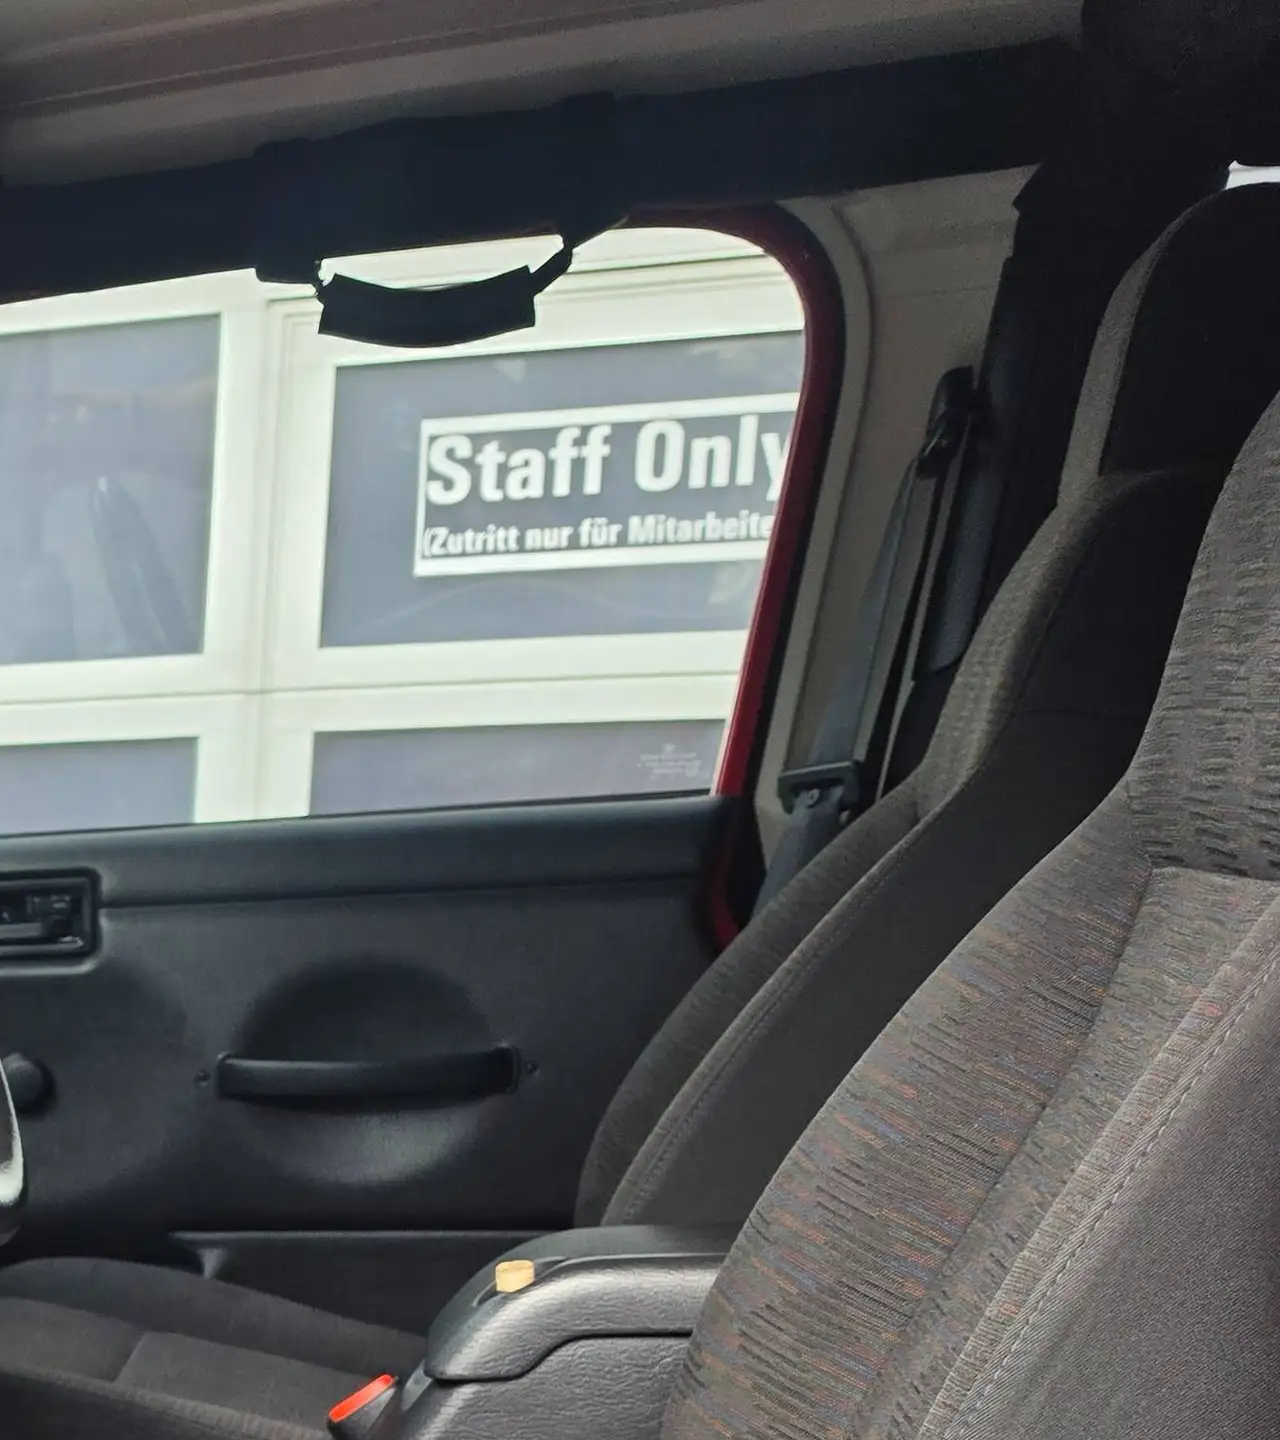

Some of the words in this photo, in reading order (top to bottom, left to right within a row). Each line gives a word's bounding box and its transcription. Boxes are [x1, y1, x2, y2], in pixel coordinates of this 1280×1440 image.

[426, 424, 612, 505] Staff
[634, 414, 790, 502] Only
[424, 524, 520, 557] (Zutritt
[525, 527, 573, 550] nur
[581, 517, 623, 547] für
[629, 510, 775, 544] Mitarbeite
